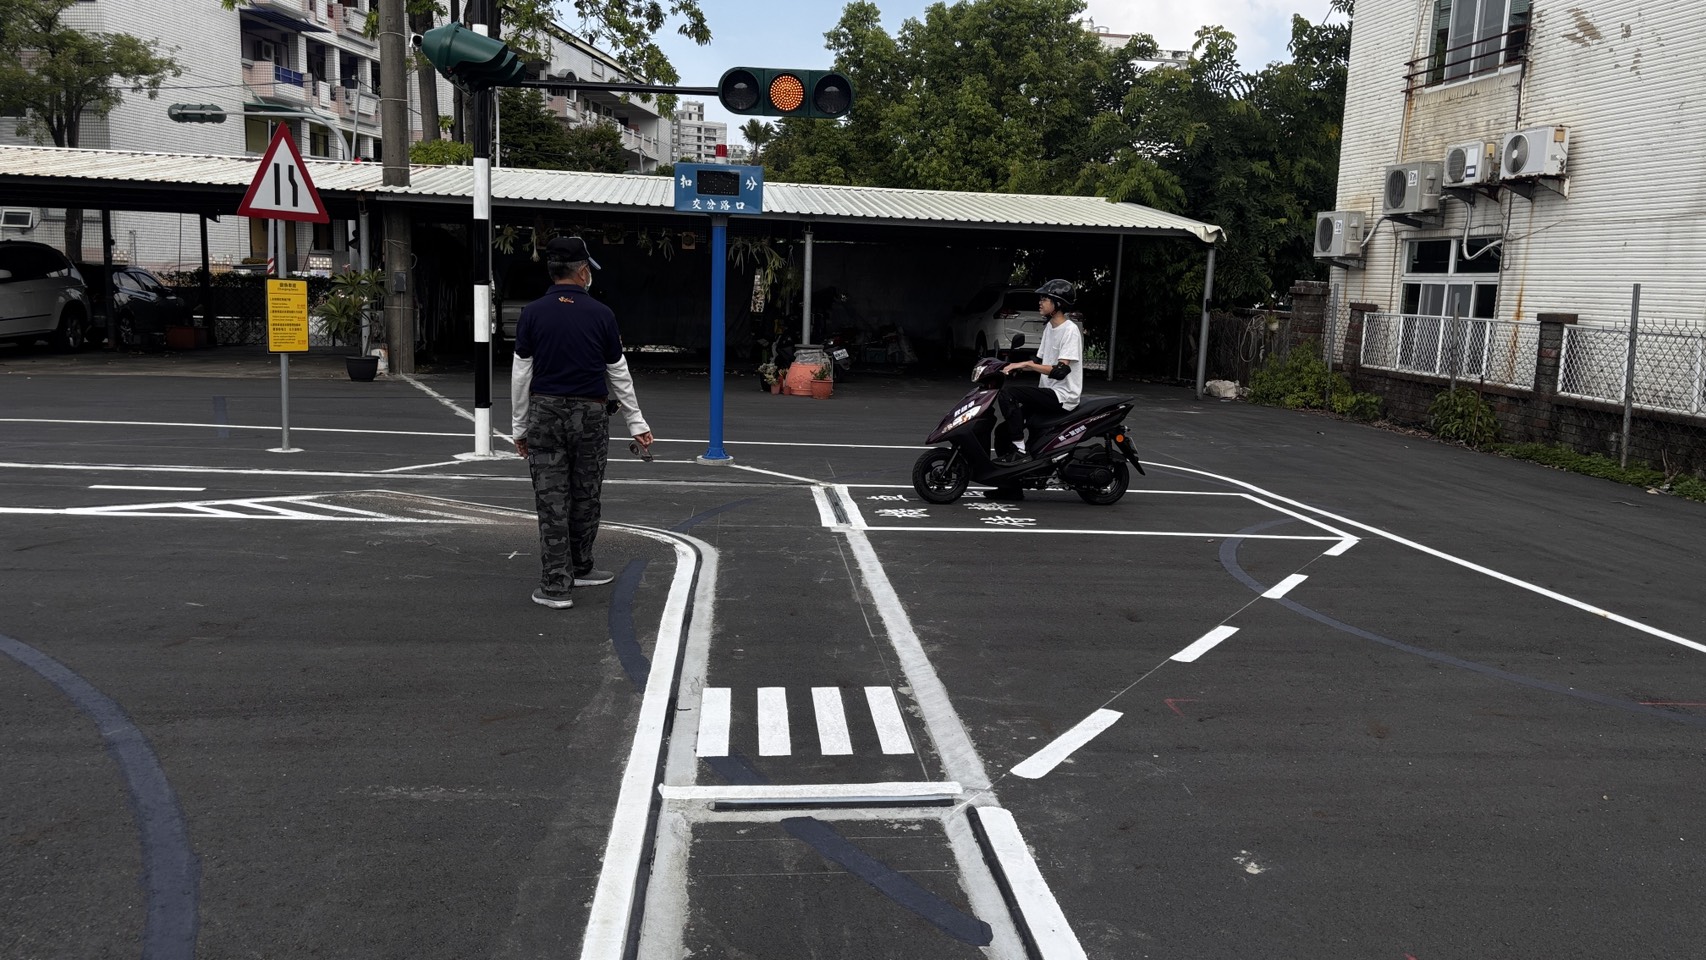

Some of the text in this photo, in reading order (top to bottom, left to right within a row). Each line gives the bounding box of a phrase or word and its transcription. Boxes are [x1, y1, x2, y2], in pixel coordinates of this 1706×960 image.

[680, 174, 758, 191] 扣 分
[692, 198, 745, 211] 交岔路口
